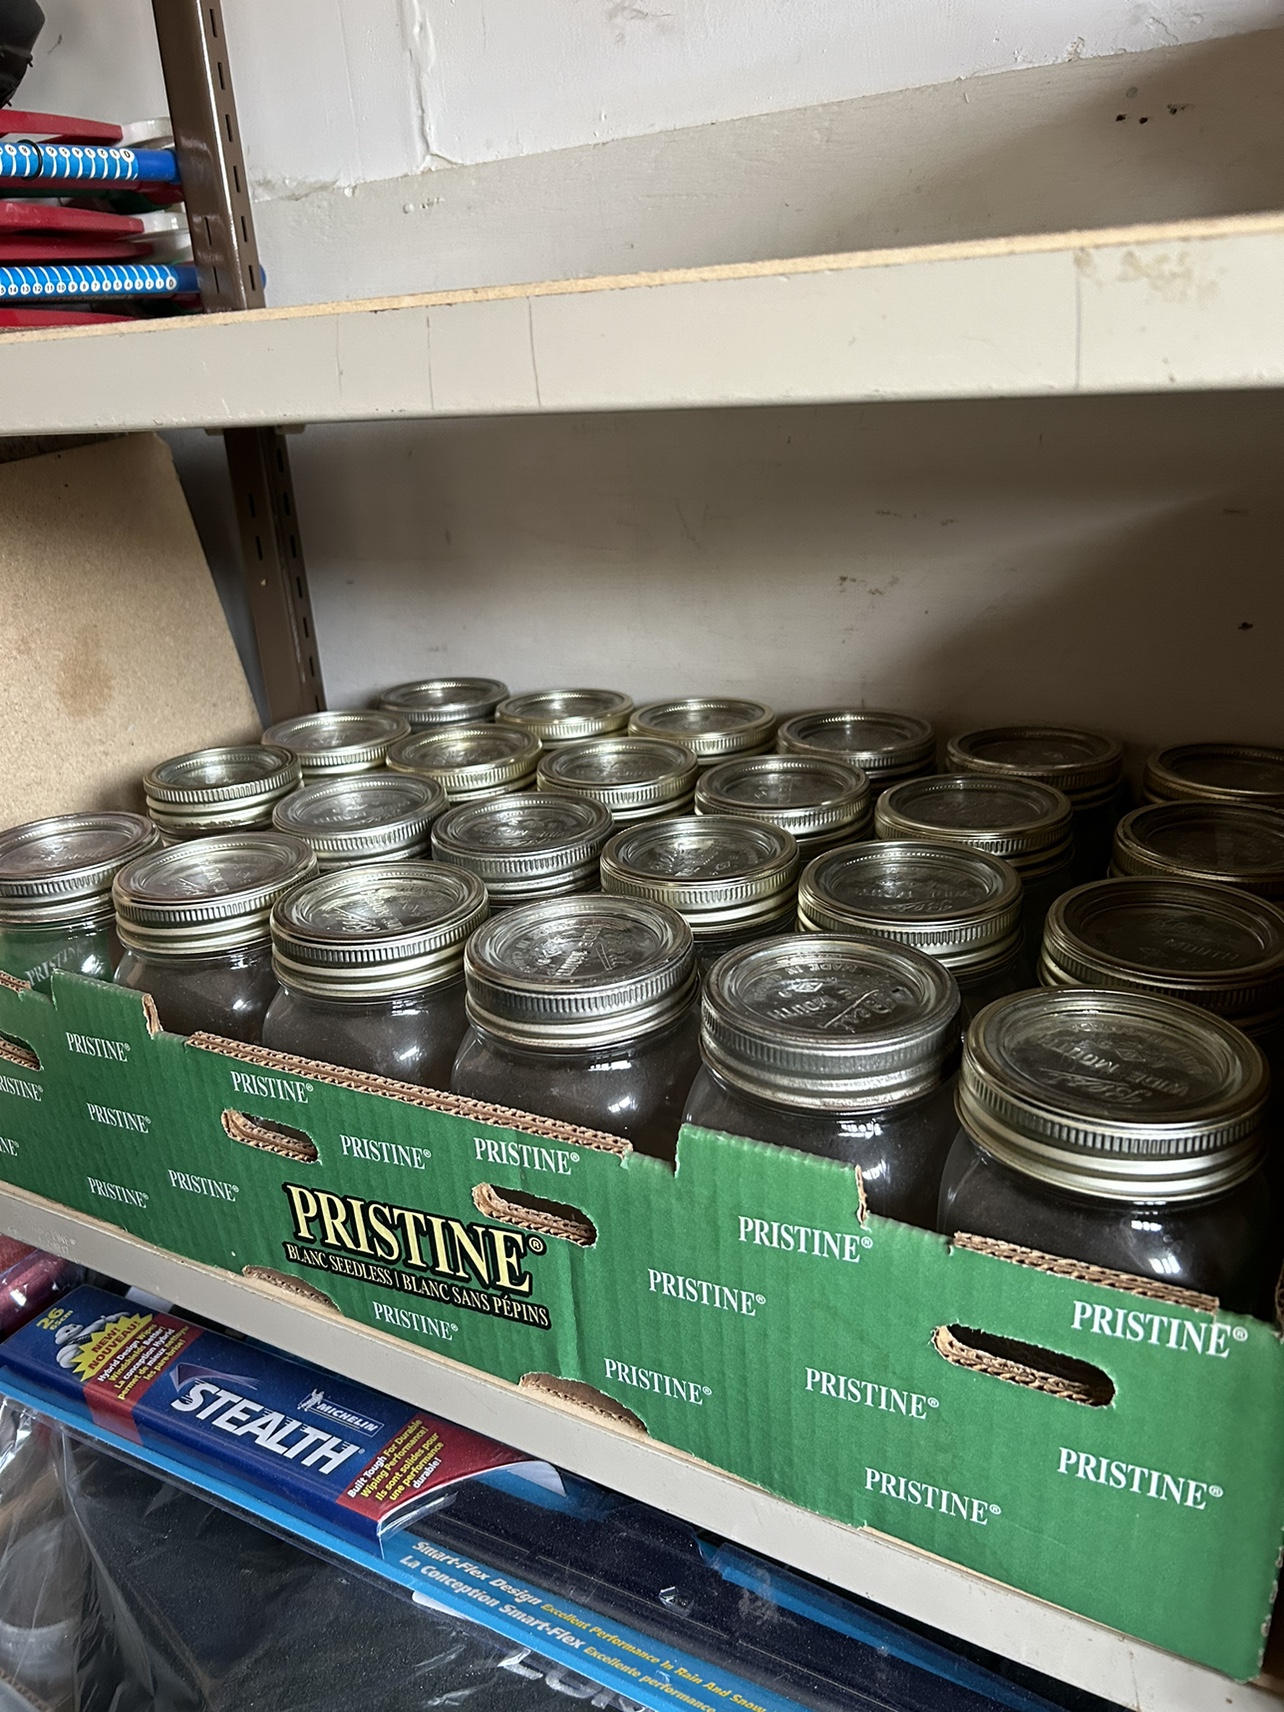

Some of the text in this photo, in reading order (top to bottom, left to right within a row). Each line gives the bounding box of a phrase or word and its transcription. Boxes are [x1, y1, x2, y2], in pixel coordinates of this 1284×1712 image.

[287, 1244, 329, 1270] BLANC
[329, 1254, 393, 1288] SEEDLESS
[400, 1273, 451, 1303] BLANC
[452, 1287, 491, 1313] SANS
[493, 1294, 550, 1328] PÉPINS
[88, 1321, 141, 1371] NOUVEAU!
[92, 1326, 122, 1353] NEW!
[97, 1359, 121, 1383] Hybrid
[116, 1339, 141, 1362] Design
[114, 1379, 127, 1390] La
[123, 1345, 156, 1381] conception
[117, 1374, 142, 1401] permet
[318, 1402, 379, 1433] MICHELIN
[346, 1418, 423, 1498] Built Tough For Durable
[360, 1426, 430, 1499] Wiping Performance!
[385, 1470, 403, 1491] sont
[400, 1448, 426, 1474] solides
[420, 1432, 441, 1455] pour
[389, 1441, 445, 1502] une performance
[412, 1457, 443, 1490] durable!
[399, 1554, 420, 1571] La
[419, 1563, 501, 1609] Conception
[497, 1601, 587, 1651] Smart-Flex
[581, 1643, 643, 1680] Excellente
[411, 1540, 491, 1583] Smart-Flex
[488, 1570, 543, 1607] Design
[539, 1602, 592, 1632] Excellent
[588, 1624, 661, 1667] Performance
[660, 1656, 675, 1672] In
[672, 1665, 706, 1689] Rain
[702, 1679, 731, 1701] And
[727, 1690, 768, 1712] Snow
